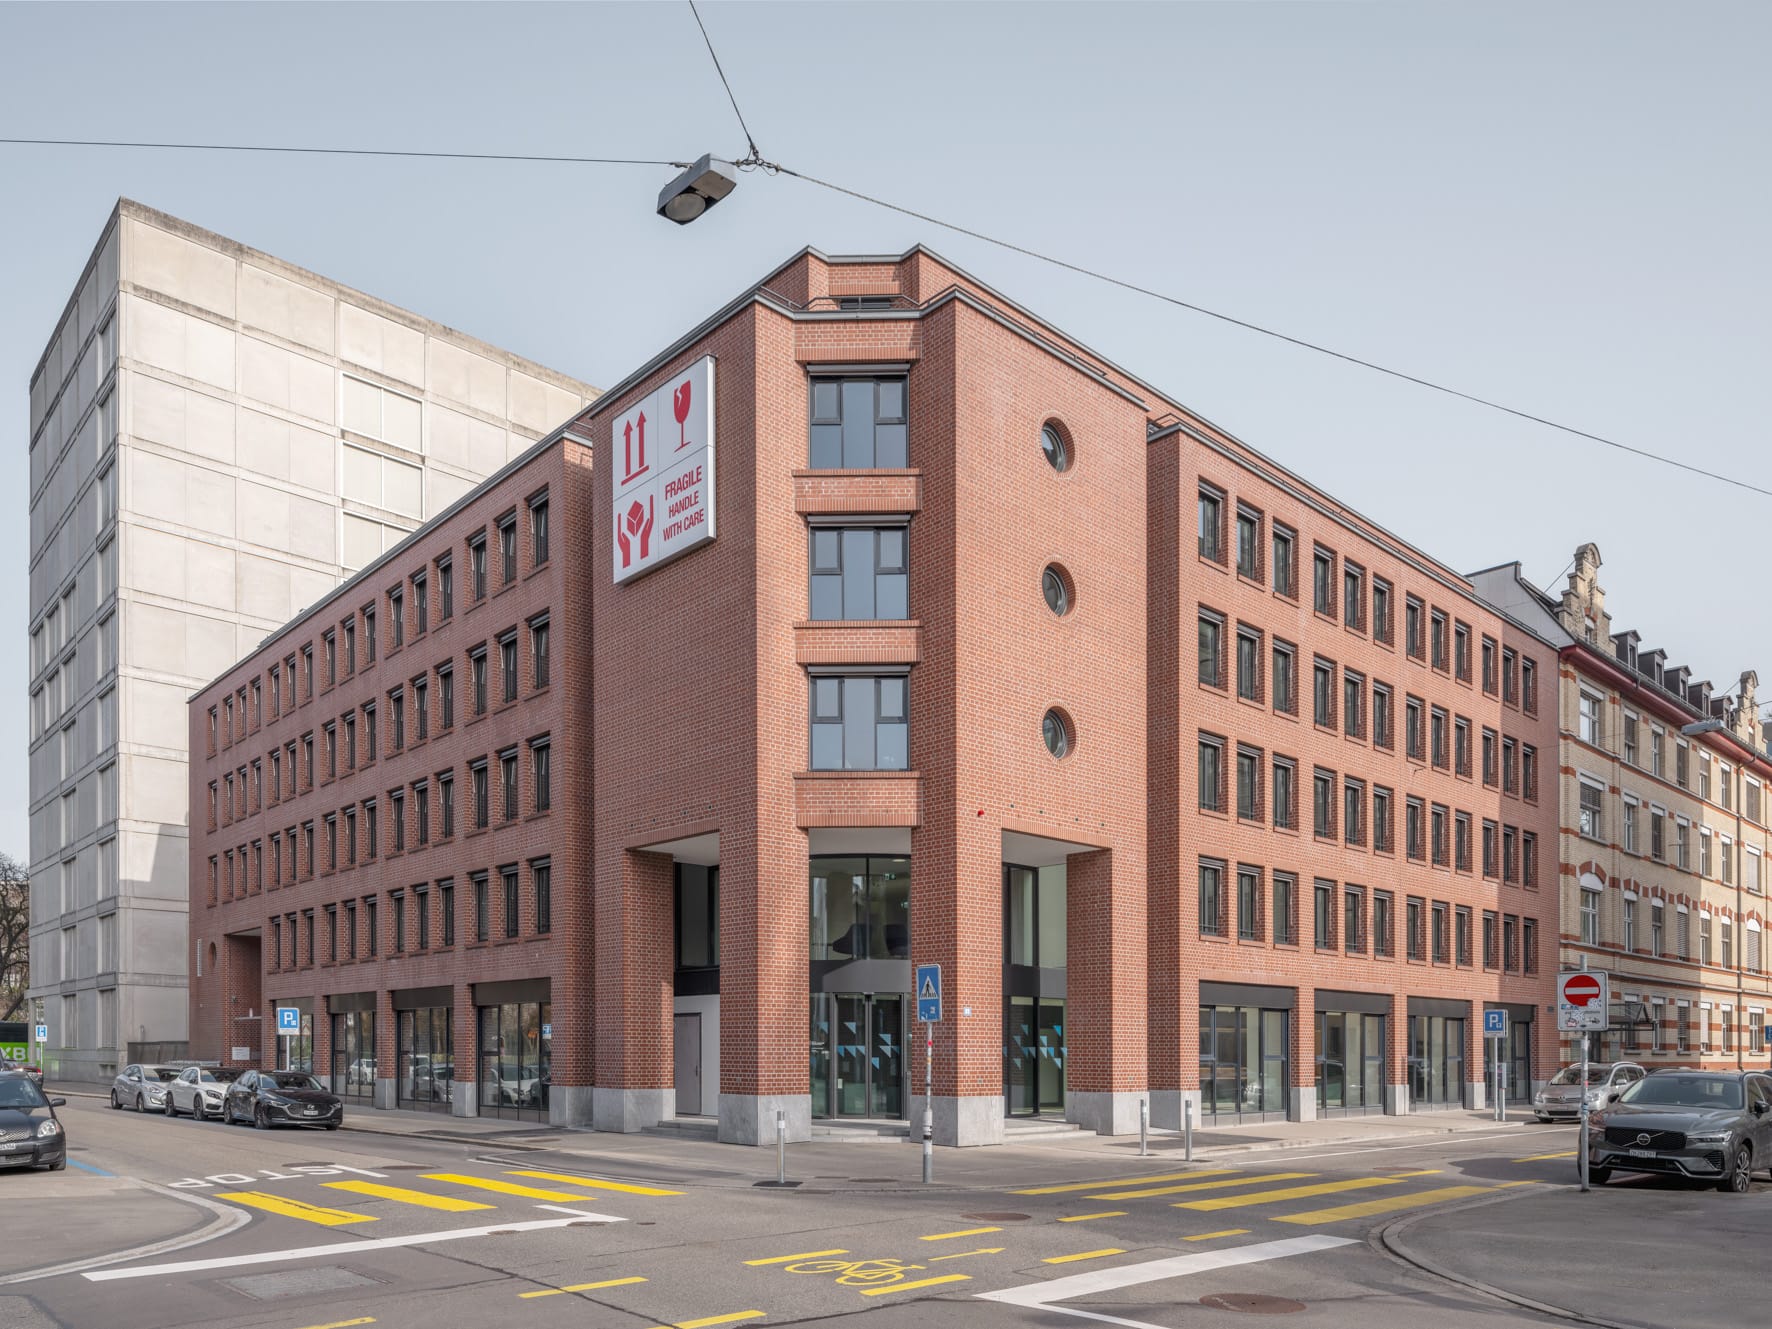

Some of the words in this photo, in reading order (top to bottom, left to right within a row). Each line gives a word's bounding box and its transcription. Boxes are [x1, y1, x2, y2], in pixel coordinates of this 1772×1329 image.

[665, 465, 702, 501] FRAGILE
[668, 490, 699, 519] HANDLE
[662, 520, 682, 541] WITH
[684, 508, 704, 531] CARE
[284, 1012, 293, 1025] P
[1489, 1015, 1498, 1028] P
[168, 1165, 343, 1188] STOP
